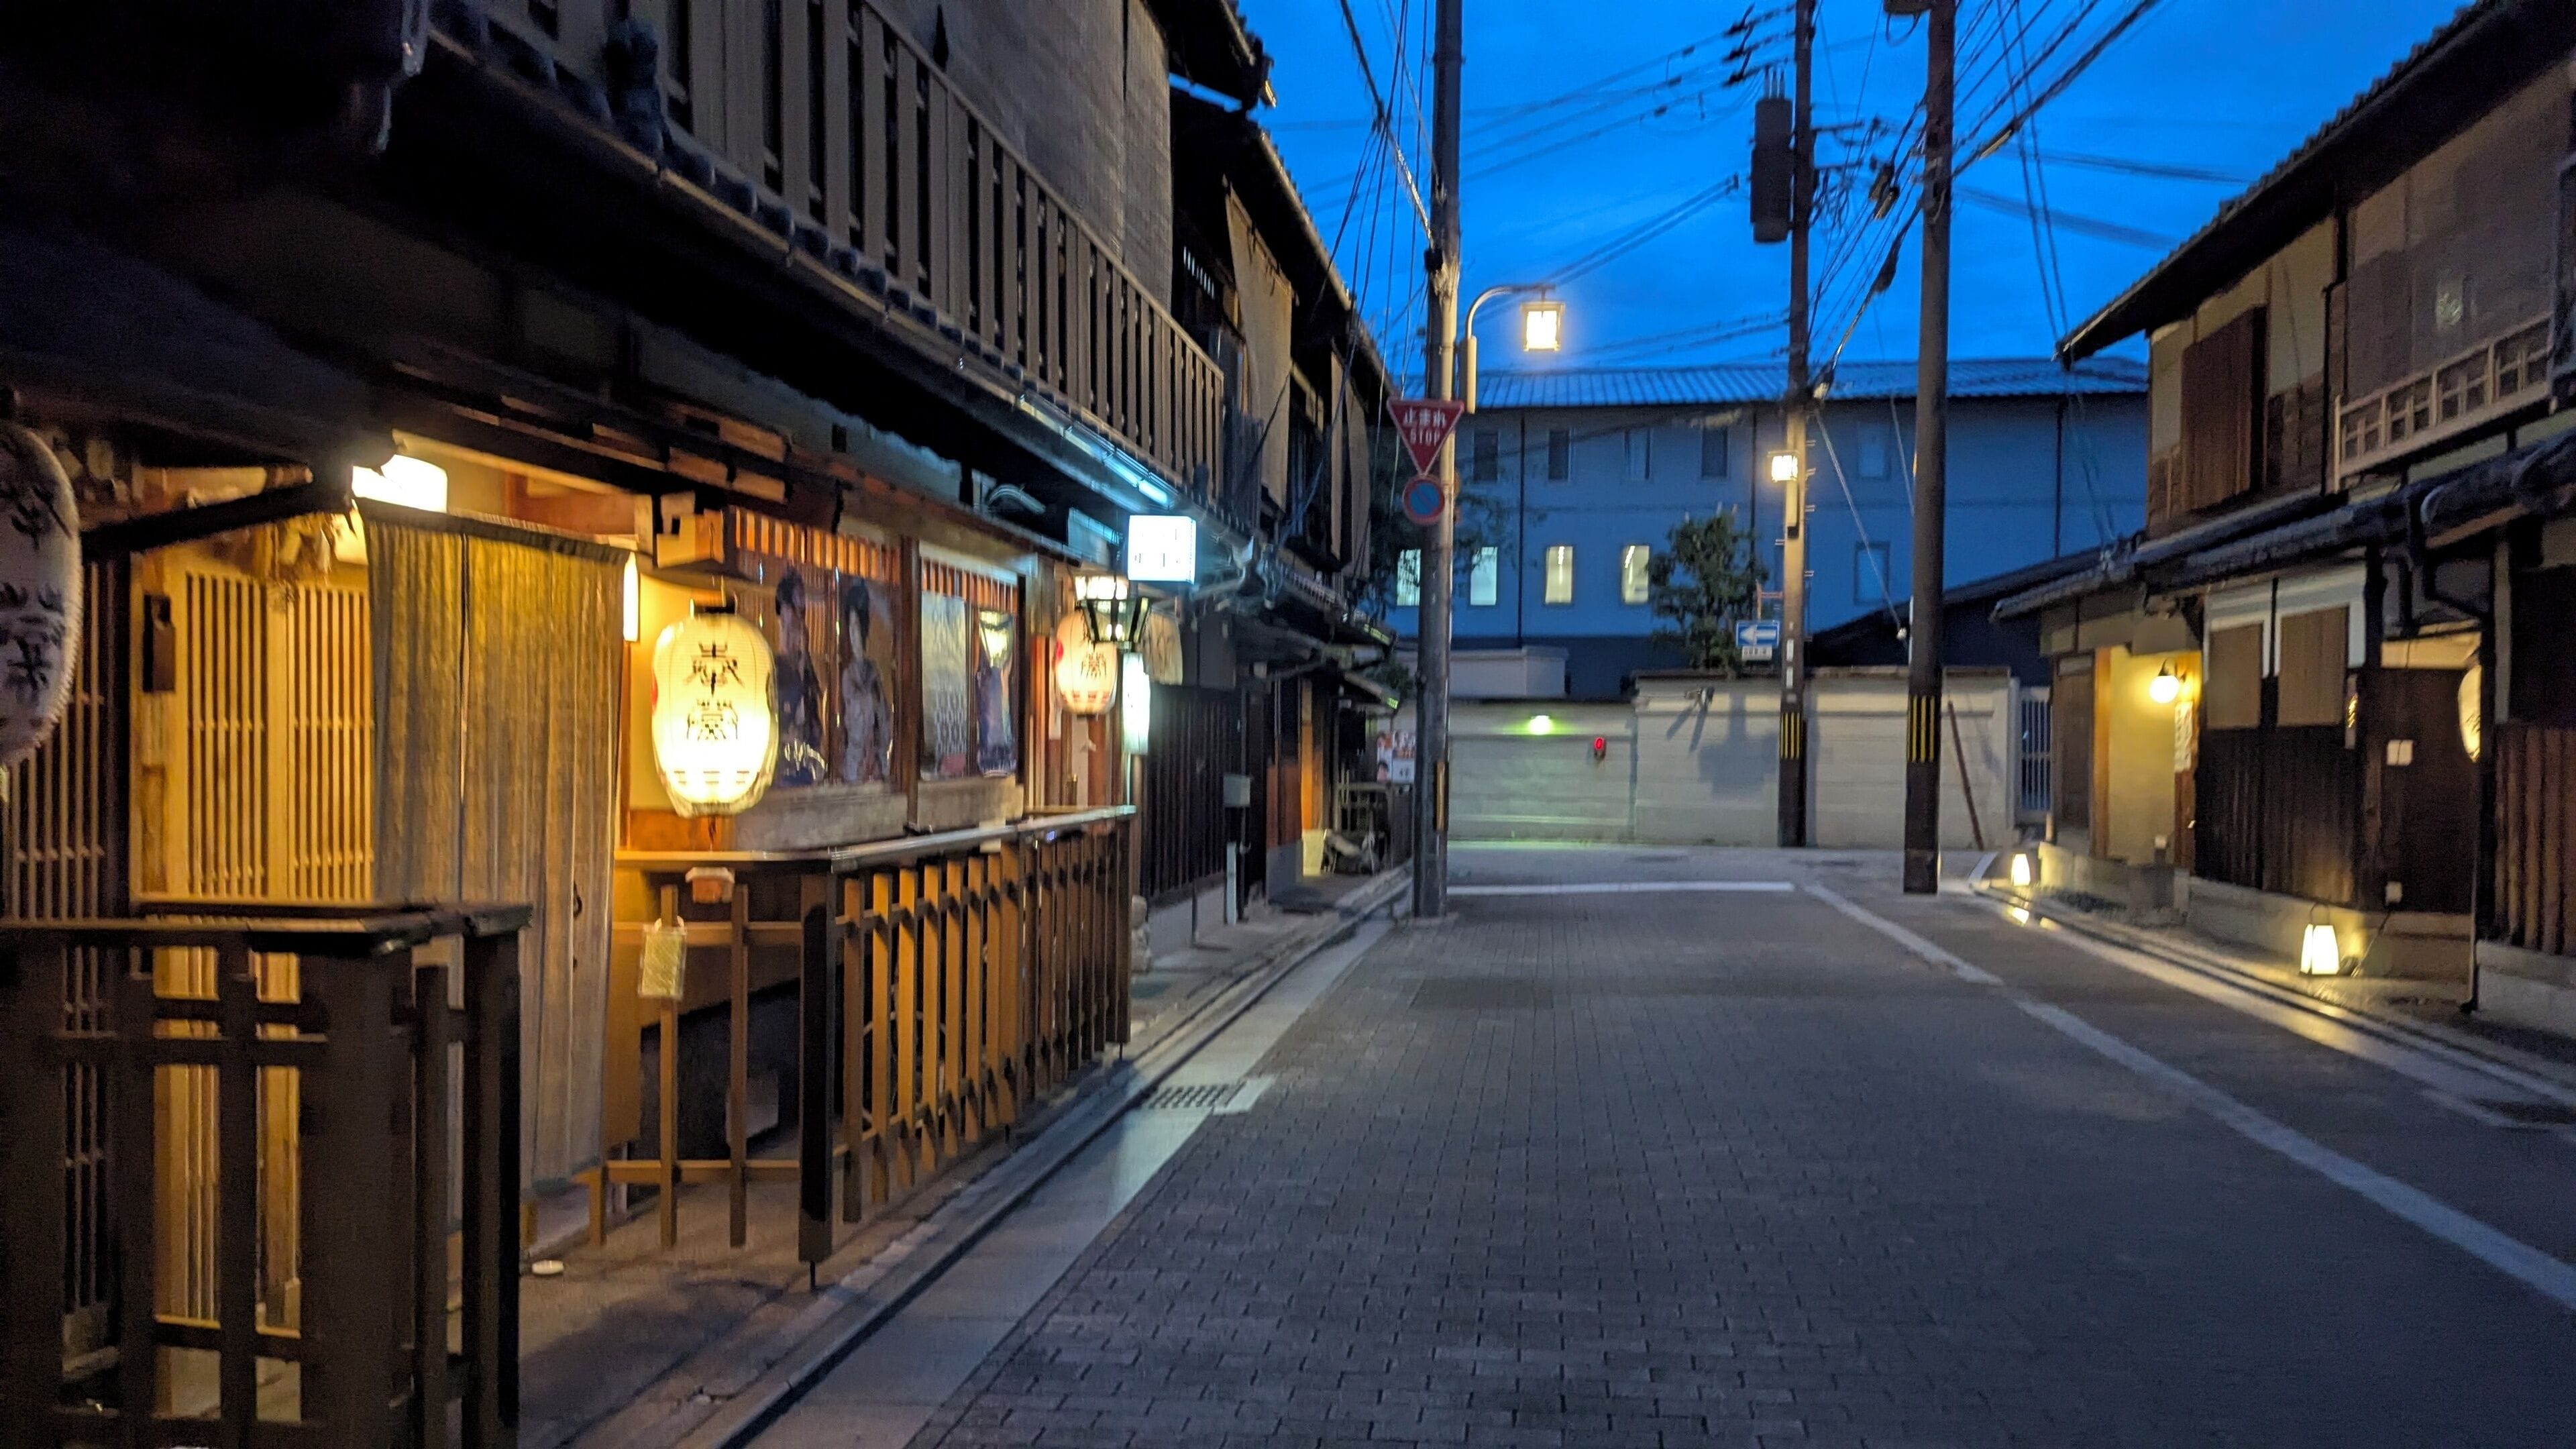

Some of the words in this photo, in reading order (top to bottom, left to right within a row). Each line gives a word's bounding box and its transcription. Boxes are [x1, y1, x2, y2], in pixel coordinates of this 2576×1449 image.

[1403, 407, 1447, 427] 止まれ
[1410, 428, 1440, 446] STOP
